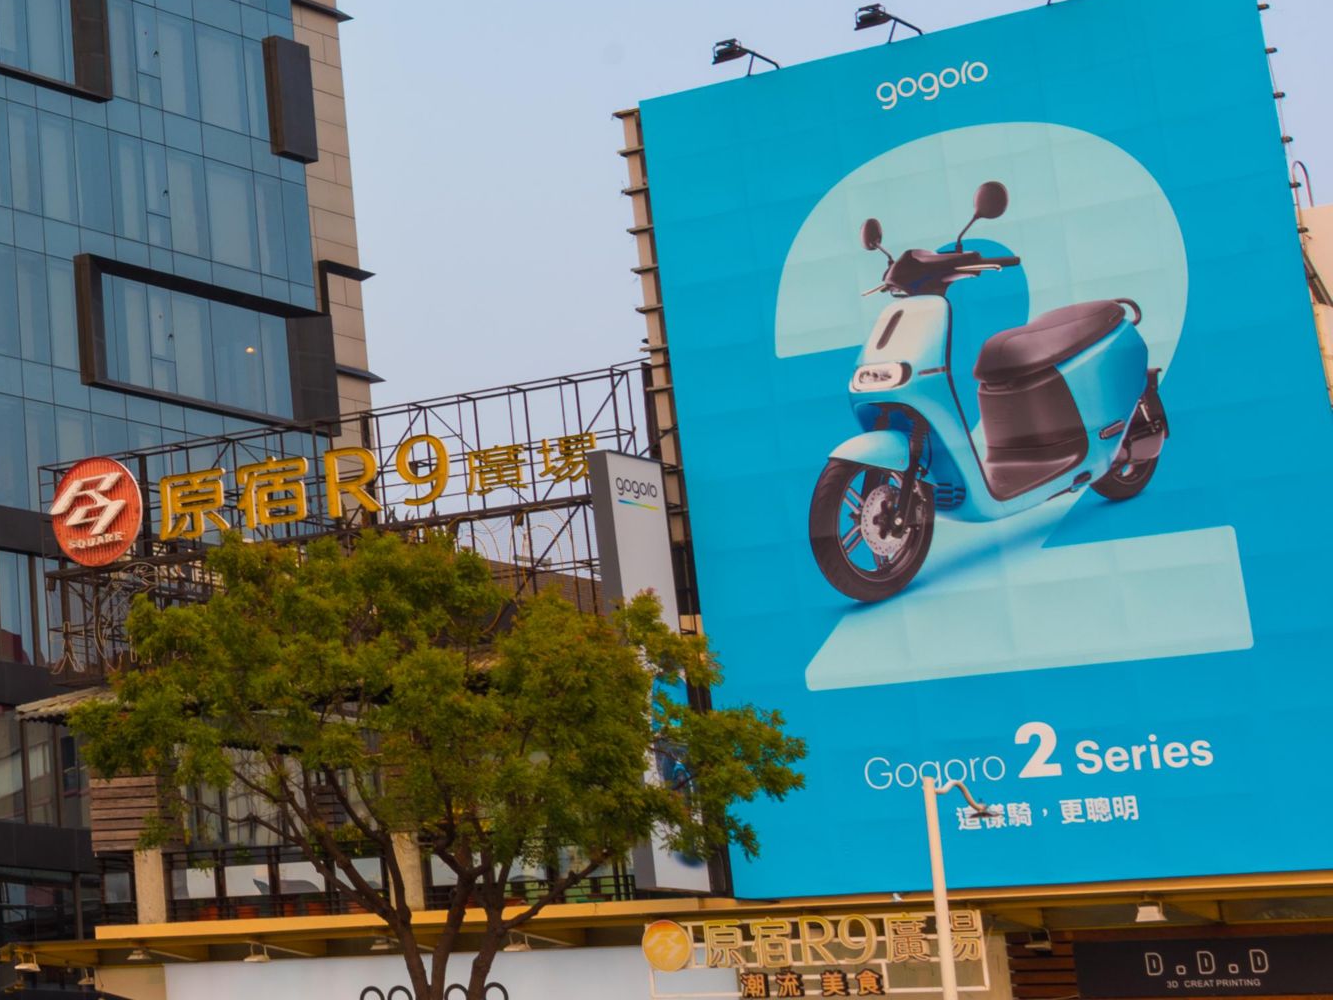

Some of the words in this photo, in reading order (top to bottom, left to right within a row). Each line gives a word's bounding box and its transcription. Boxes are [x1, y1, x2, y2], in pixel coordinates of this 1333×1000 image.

[876, 61, 989, 110] gogoro
[615, 476, 658, 499] gogoro
[67, 531, 124, 549] SQUARE
[864, 756, 1006, 790] Gogoro
[1014, 721, 1063, 778] 2
[1075, 734, 1214, 775] Series
[741, 971, 803, 998] 潮流
[821, 969, 883, 996] 美食
[1166, 980, 1179, 989] 3D
[1184, 979, 1214, 988] CREAT
[1215, 978, 1261, 988] PRINTING
